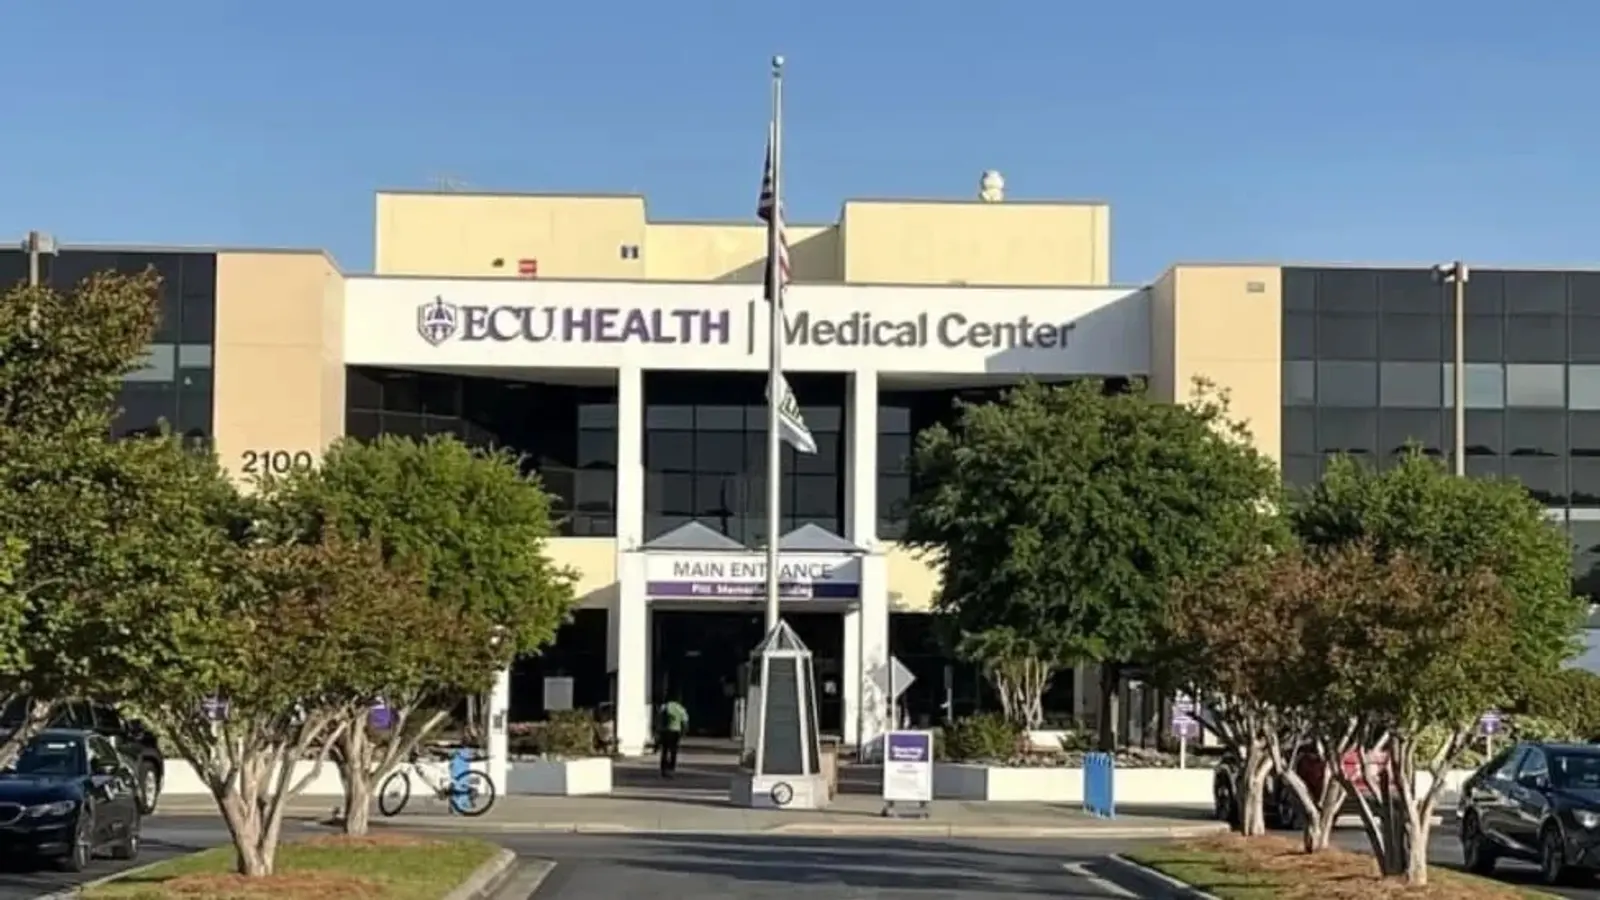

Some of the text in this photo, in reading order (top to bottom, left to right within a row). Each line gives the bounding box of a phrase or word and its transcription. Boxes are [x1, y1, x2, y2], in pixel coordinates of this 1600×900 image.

[460, 305, 1076, 348] ECU HEALTH Medical Center
[241, 449, 312, 474] 2100
[673, 560, 833, 580] MAIN ENTANCE
